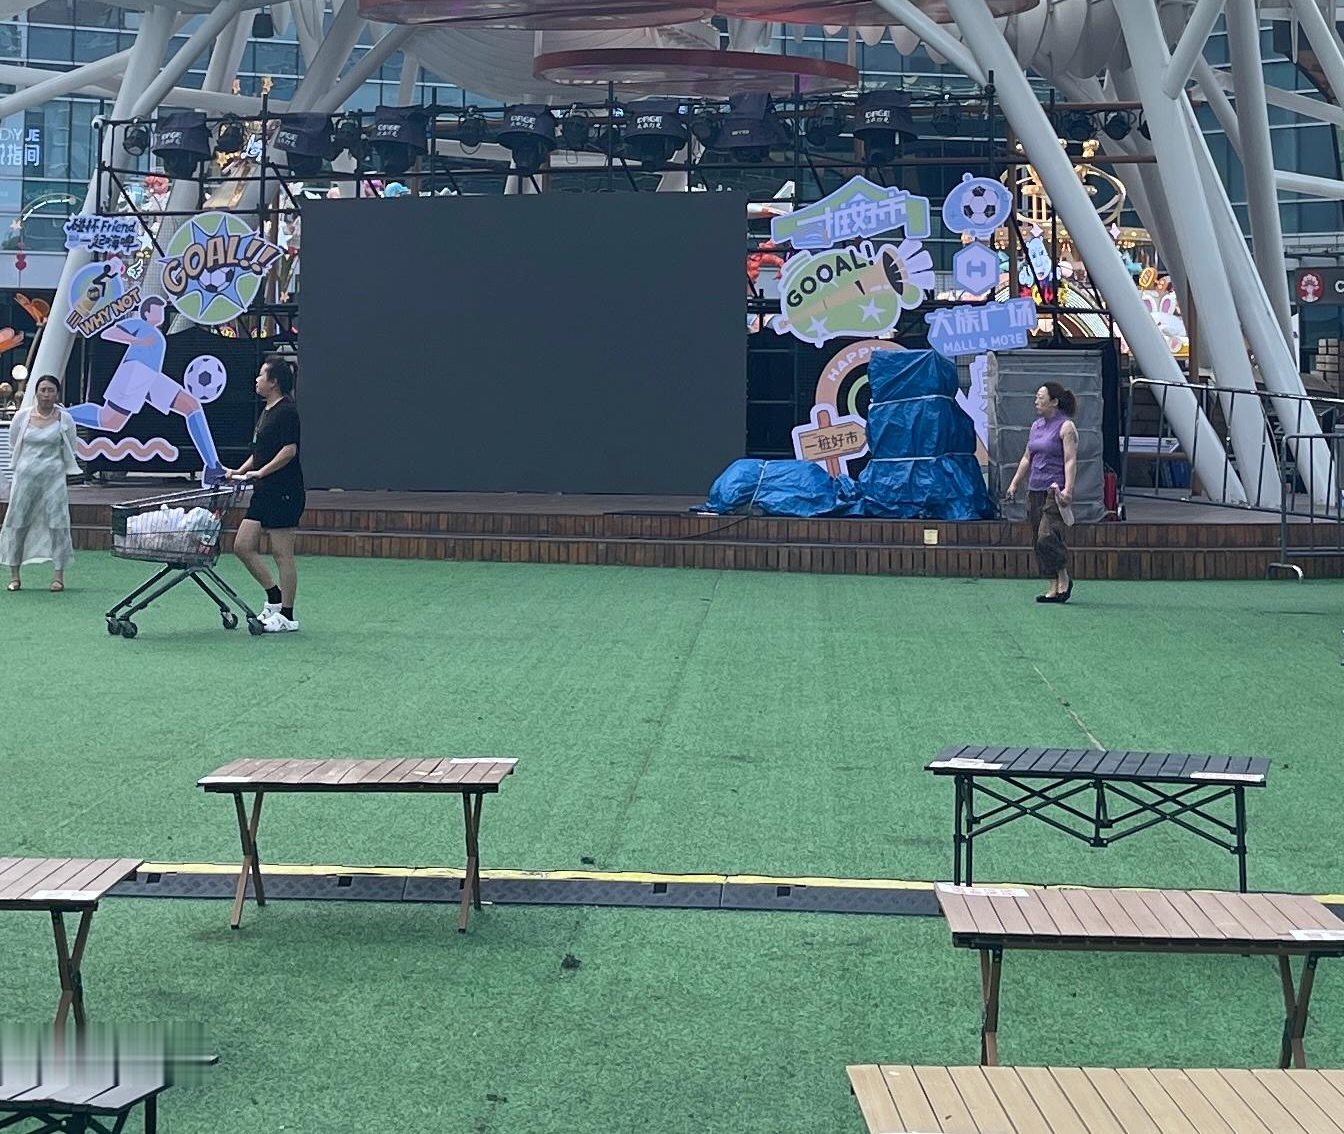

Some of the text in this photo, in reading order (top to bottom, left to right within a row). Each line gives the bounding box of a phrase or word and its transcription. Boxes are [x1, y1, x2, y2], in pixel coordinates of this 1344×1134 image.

[163, 234, 280, 296] GOAL!!
[787, 244, 875, 307] GOOAL!
[78, 287, 142, 336] WHY NOT
[929, 301, 1035, 339] 大族广场
[943, 339, 977, 353] MALL
[990, 332, 1025, 346] MORE
[806, 431, 858, 451] 一桩好市
